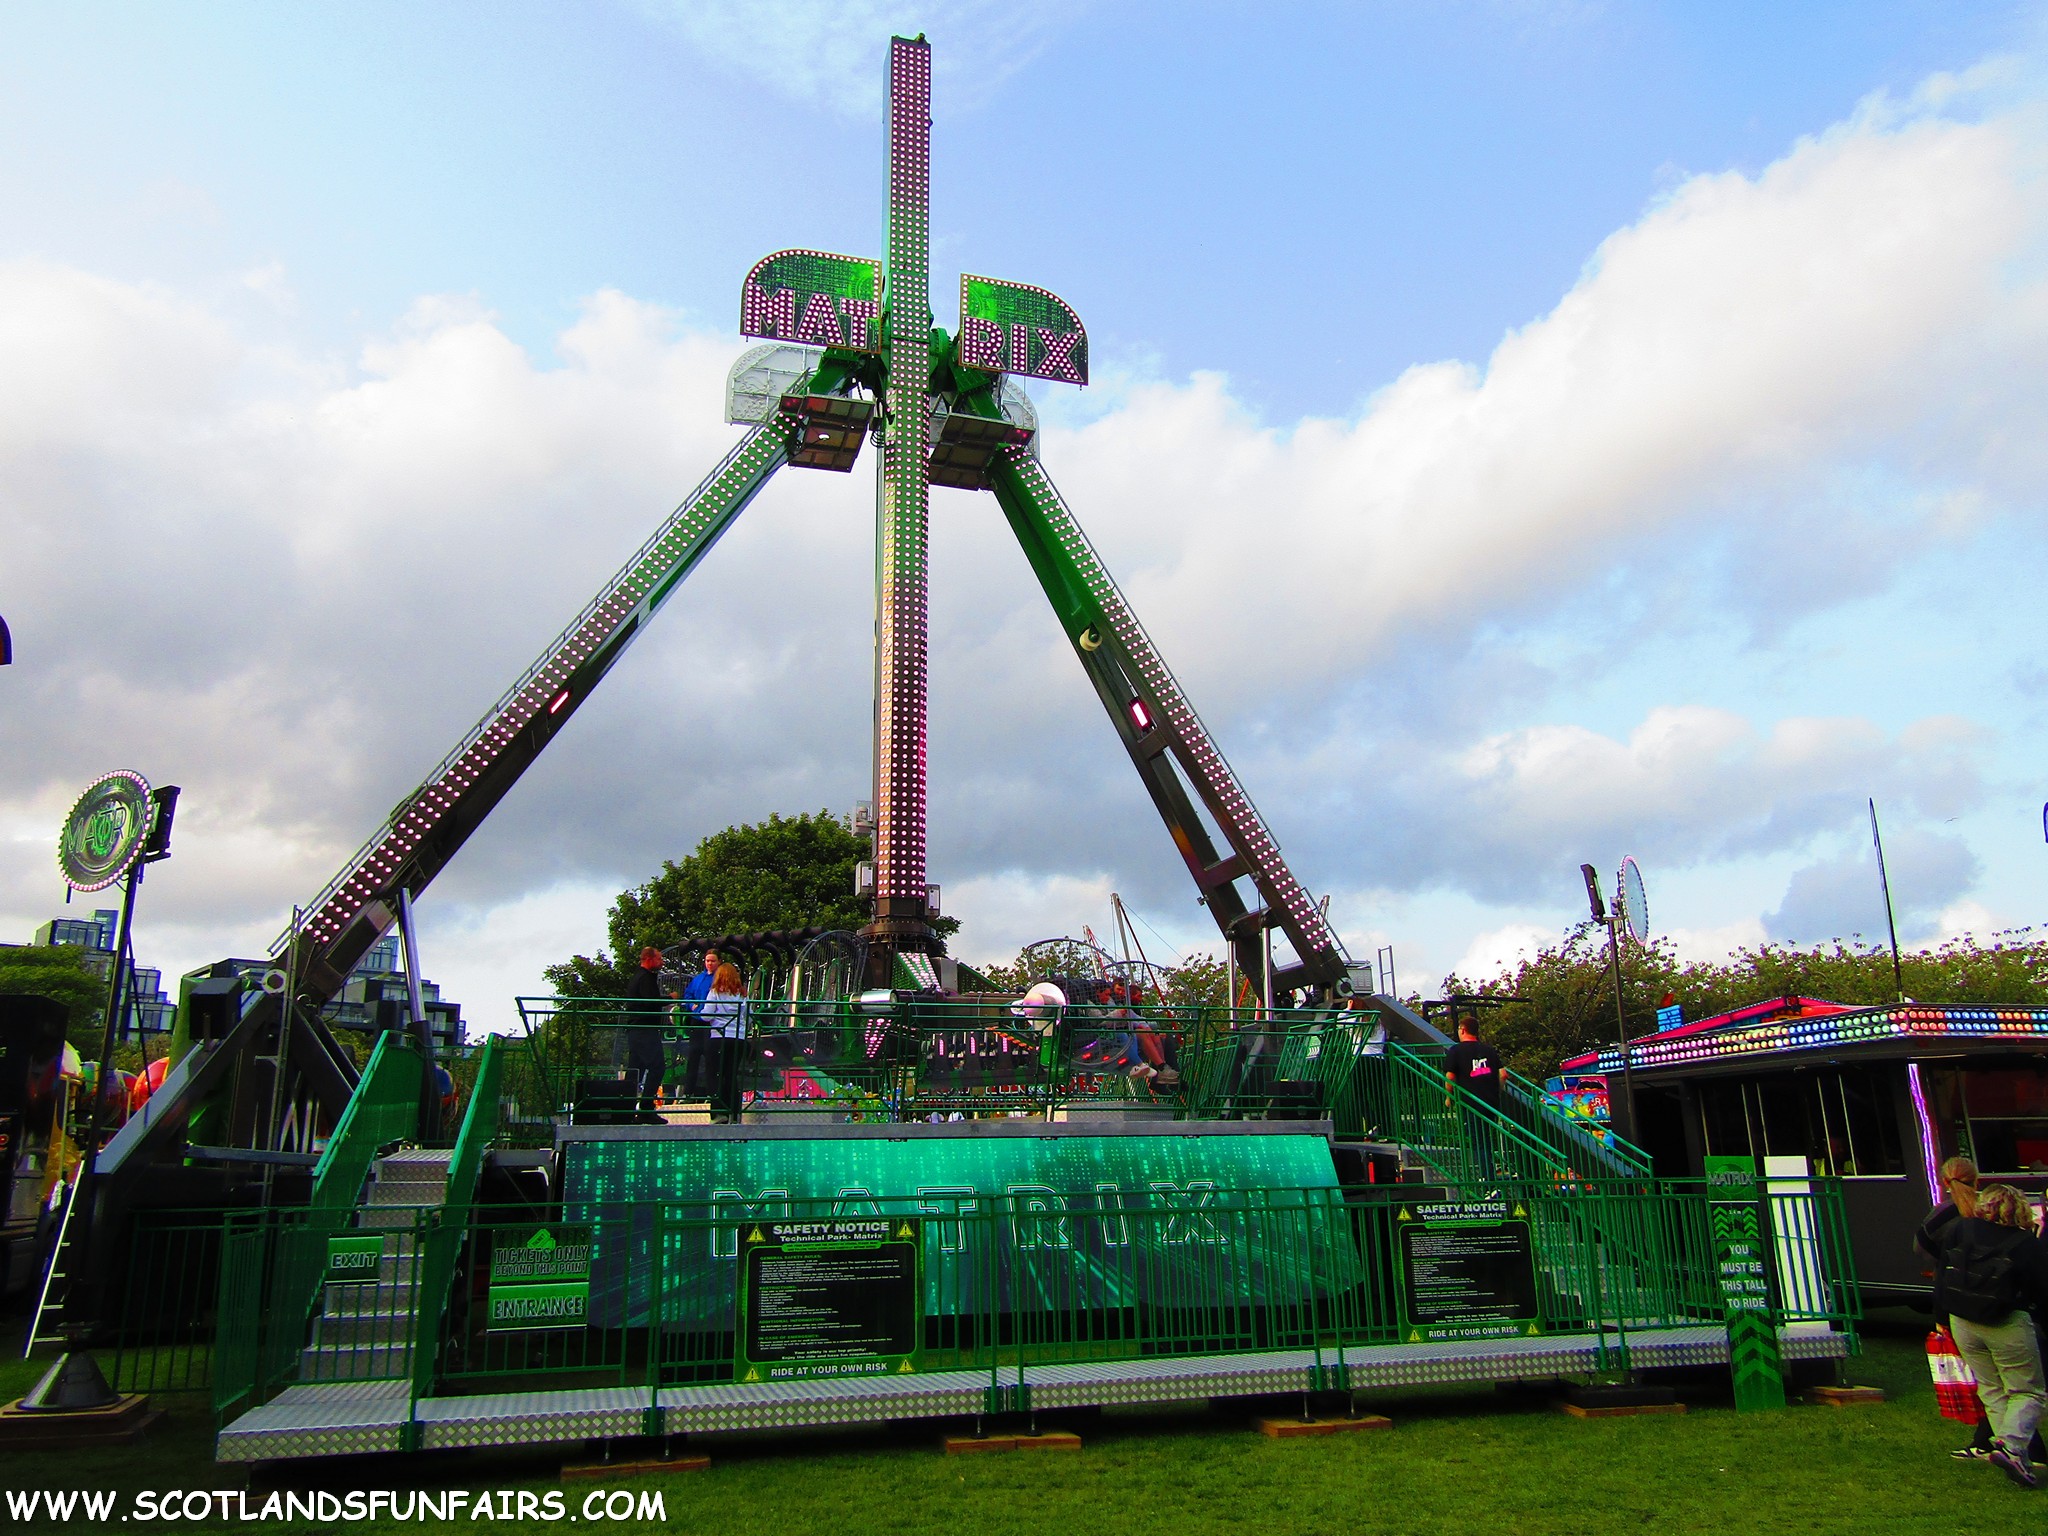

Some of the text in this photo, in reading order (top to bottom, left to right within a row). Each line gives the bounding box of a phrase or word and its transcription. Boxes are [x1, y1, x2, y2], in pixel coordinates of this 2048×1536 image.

[744, 284, 1084, 381] MAT RIX
[1708, 1171, 1754, 1185] MATRIX
[1417, 1202, 1507, 1214] SAFETY NOTICE
[1422, 1213, 1457, 1221] Technical
[1479, 1211, 1502, 1219] Matrix
[773, 1221, 890, 1235] SAFETY NOTICE
[780, 1234, 825, 1242] Technical
[853, 1232, 883, 1240] Matrix
[495, 1245, 589, 1264] TICKETS ONLY
[1729, 1244, 1749, 1255] YOU
[331, 1252, 377, 1269] EXIT
[1720, 1261, 1763, 1272] MUST BE
[495, 1261, 588, 1276] BEYOND THIS POINT
[1720, 1279, 1768, 1290] THIS TALL
[493, 1295, 584, 1319] ENTRANCE
[1727, 1297, 1766, 1309] TO RIDE
[1428, 1325, 1519, 1338] RIDE AT YOUR OWN RISK
[771, 1362, 888, 1377] RIDE AT YOUR OWN RISK
